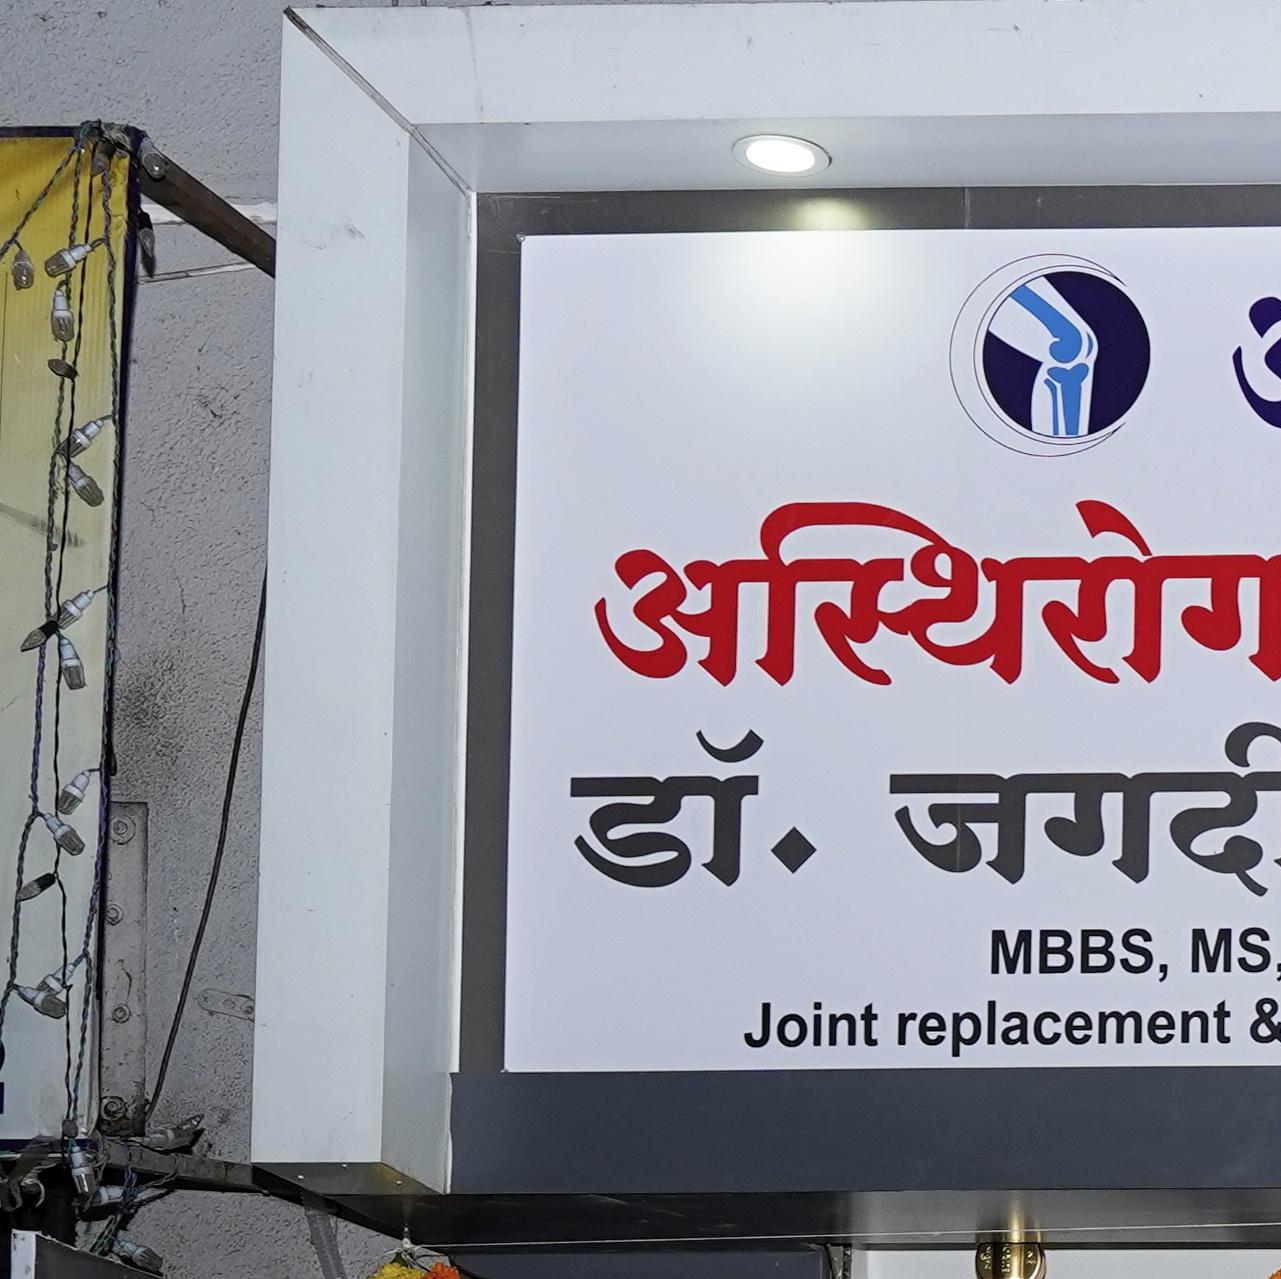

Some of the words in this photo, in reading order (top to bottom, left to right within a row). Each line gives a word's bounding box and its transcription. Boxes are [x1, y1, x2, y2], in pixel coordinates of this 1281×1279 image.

[570, 729, 817, 888] डॉ.
[991, 928, 1168, 982] MBBS,
[744, 1002, 878, 1048] Joint
[898, 1000, 1231, 1057] replacement
